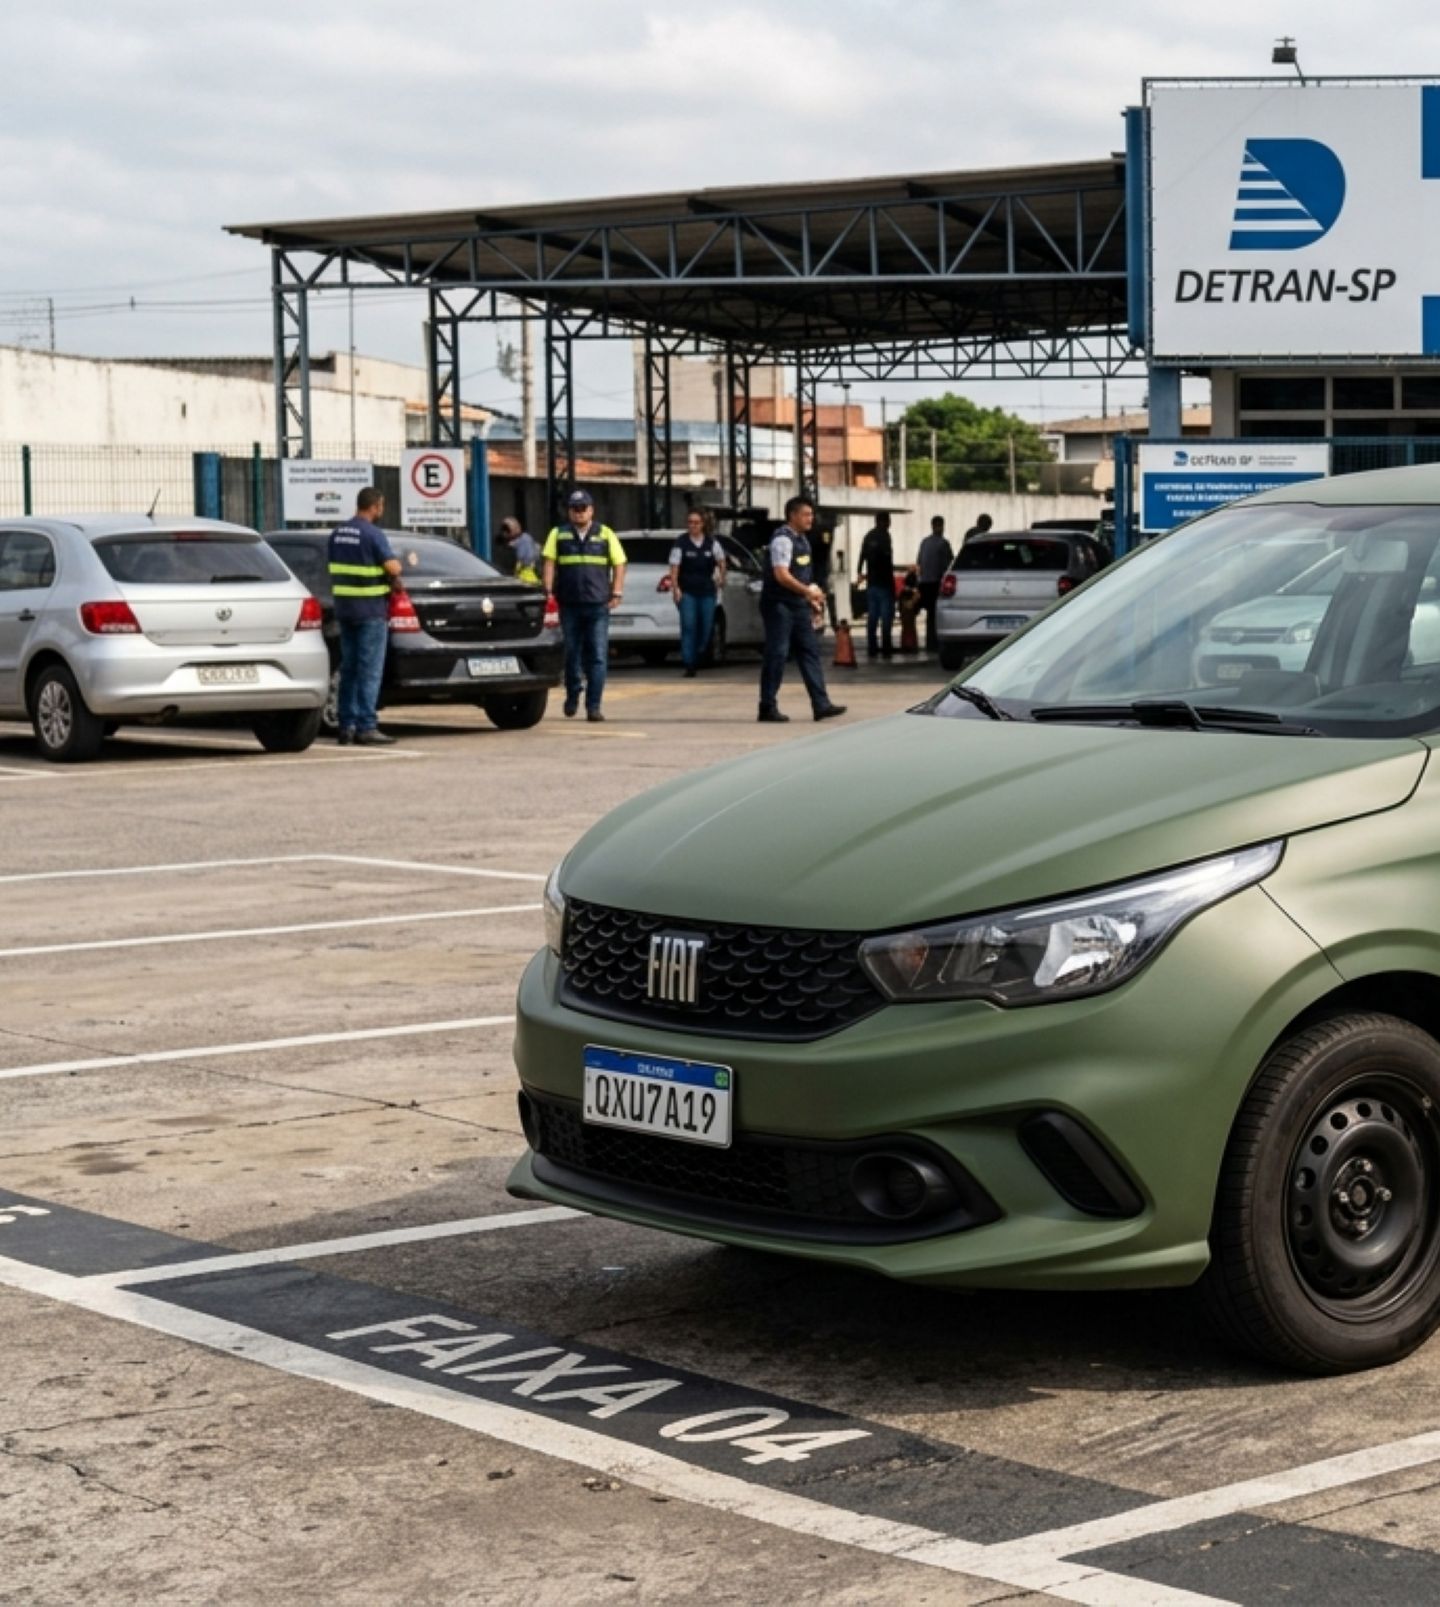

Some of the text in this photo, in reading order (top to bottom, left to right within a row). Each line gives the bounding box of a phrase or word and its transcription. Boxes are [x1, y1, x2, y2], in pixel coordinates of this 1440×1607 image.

[1174, 267, 1398, 304] DETRAN-SP
[423, 464, 441, 488] E
[647, 935, 705, 1002] FIAT
[595, 1074, 717, 1134] QXU7A19
[325, 1313, 873, 1466] FAIXA 04
